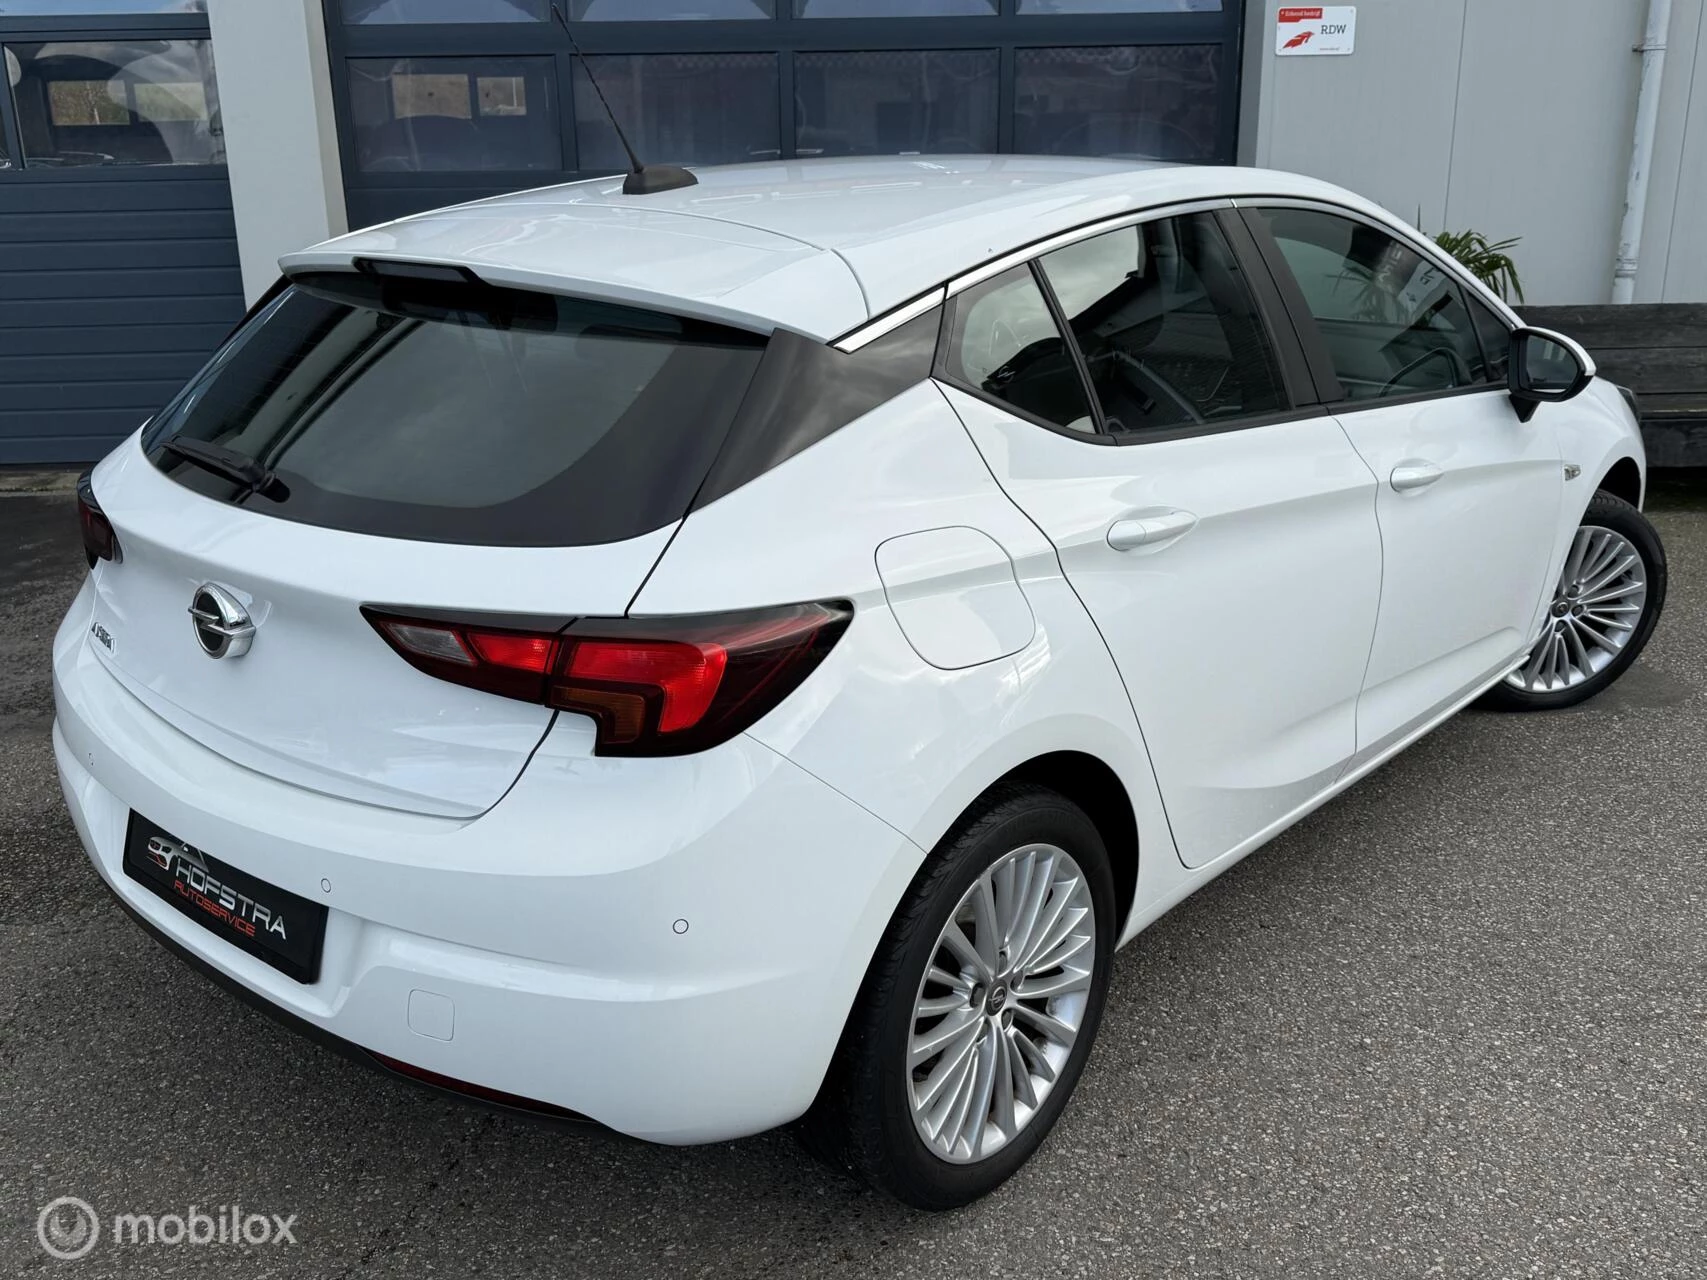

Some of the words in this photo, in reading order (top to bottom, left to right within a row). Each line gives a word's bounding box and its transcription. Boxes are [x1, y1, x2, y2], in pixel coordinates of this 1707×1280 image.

[1320, 24, 1346, 35] RDW
[174, 879, 256, 937] AUTOSERVICE
[175, 857, 286, 940] HOFSTRA
